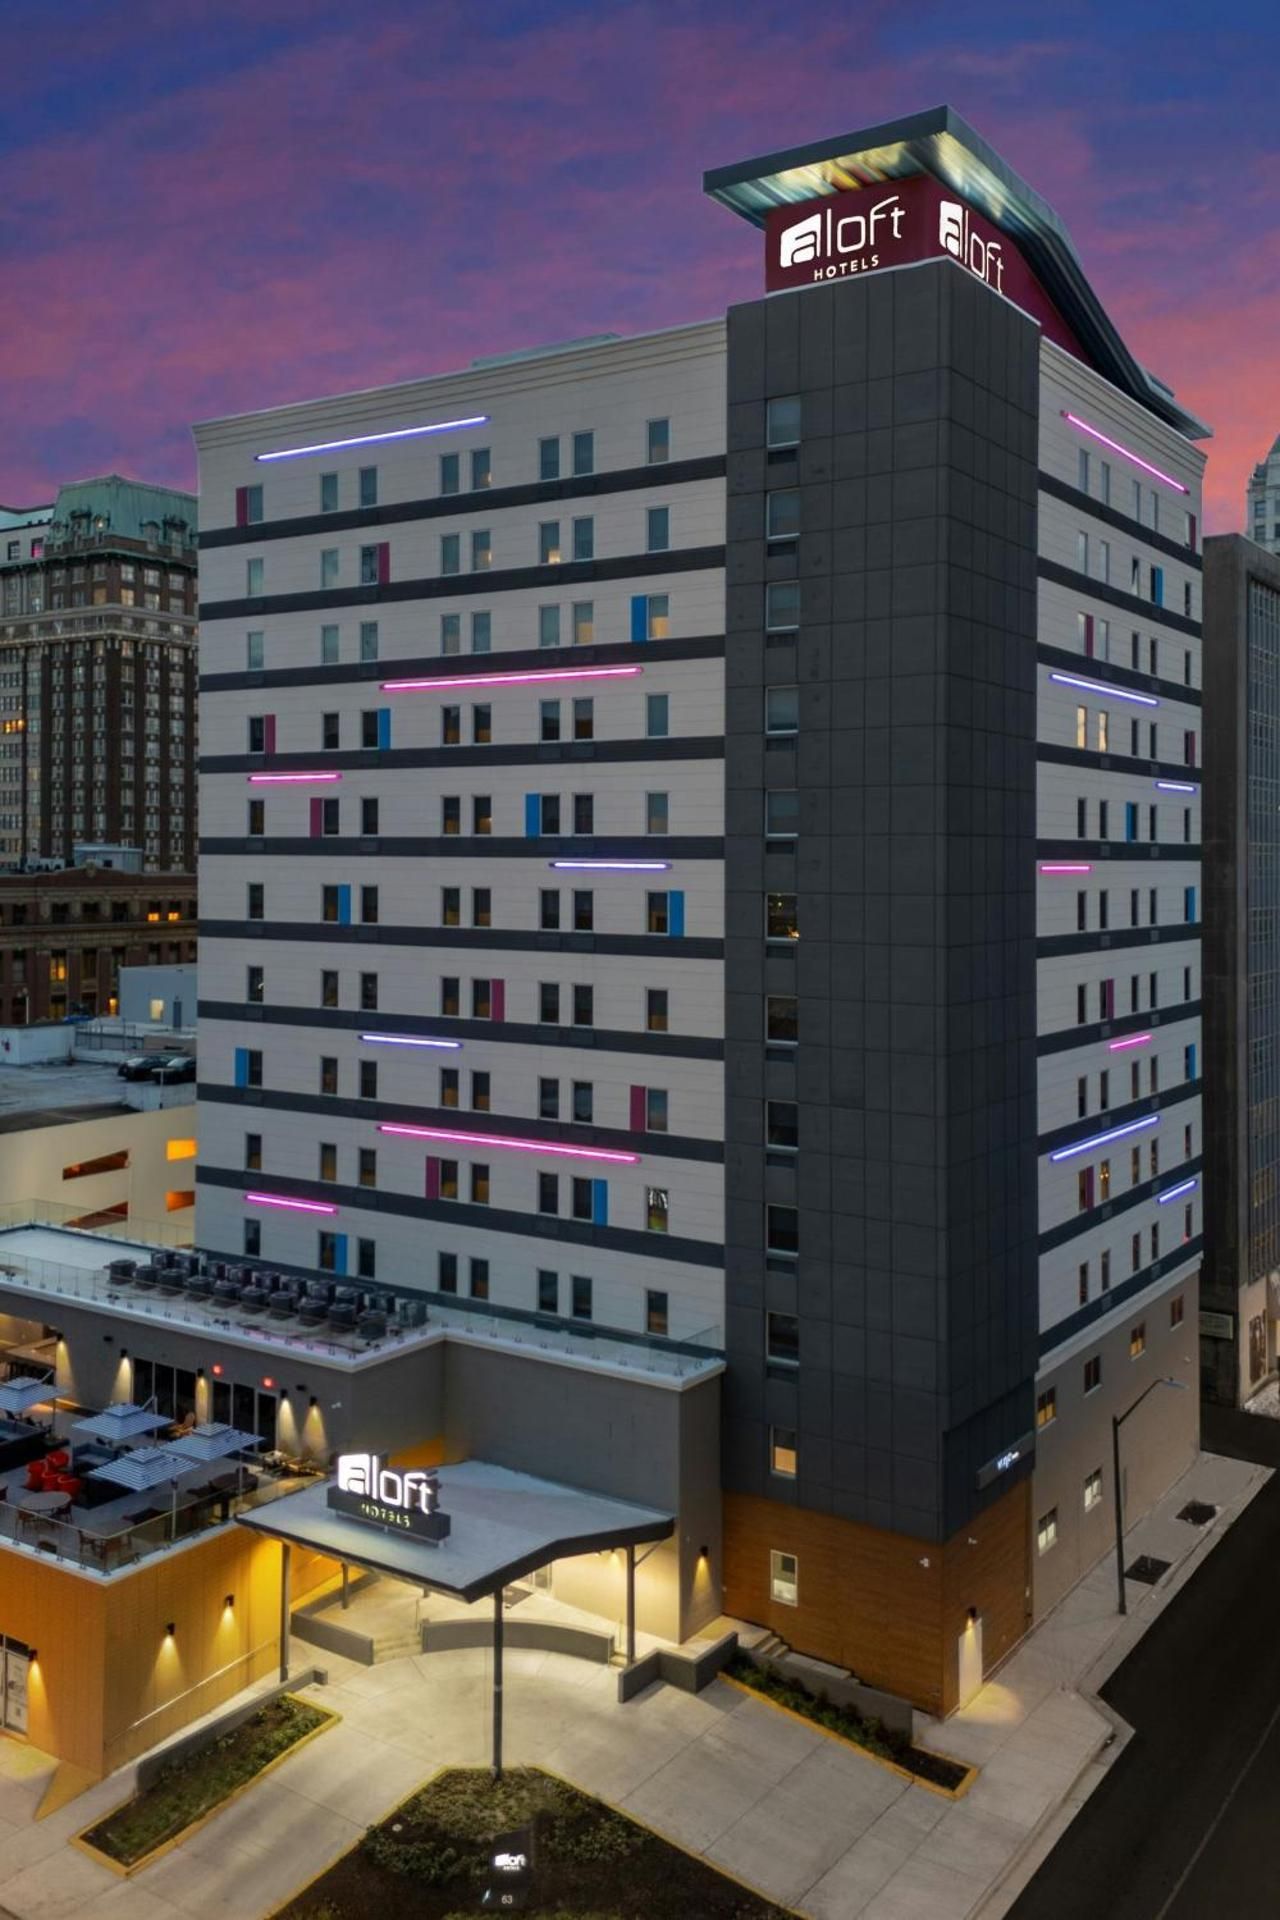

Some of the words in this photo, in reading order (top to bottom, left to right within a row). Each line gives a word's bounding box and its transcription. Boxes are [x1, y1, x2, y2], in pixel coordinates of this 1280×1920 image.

[780, 195, 905, 268] aloft
[939, 200, 1004, 294] aloft
[814, 254, 880, 281] HOTELS
[338, 1453, 433, 1515] aloft
[501, 1894, 513, 1905] 63
